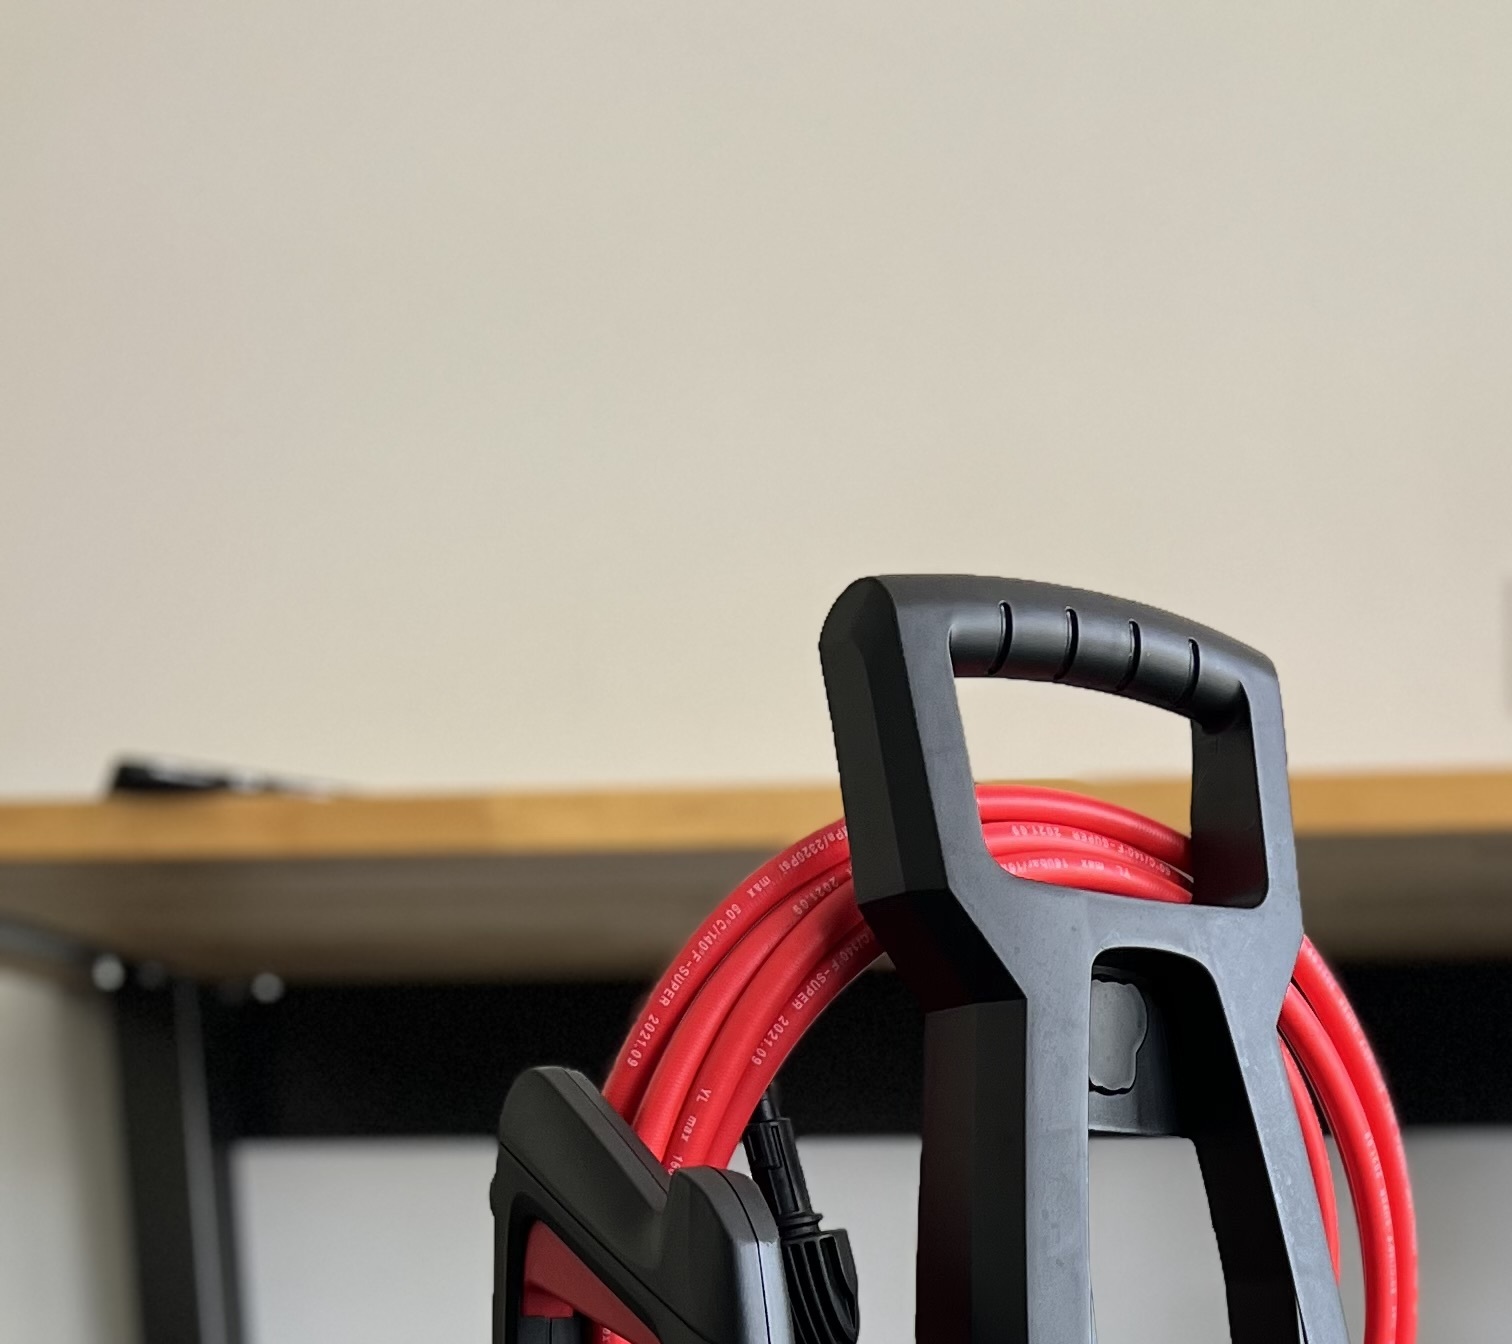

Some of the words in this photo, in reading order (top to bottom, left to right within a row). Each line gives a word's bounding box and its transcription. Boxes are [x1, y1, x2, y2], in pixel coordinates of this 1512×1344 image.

[746, 875, 771, 899] max
[792, 876, 839, 916] 2021.09
[626, 1013, 660, 1068] 2021.09
[751, 1015, 790, 1066] 2021.09
[695, 1088, 712, 1103] YL
[680, 1114, 698, 1143] max
